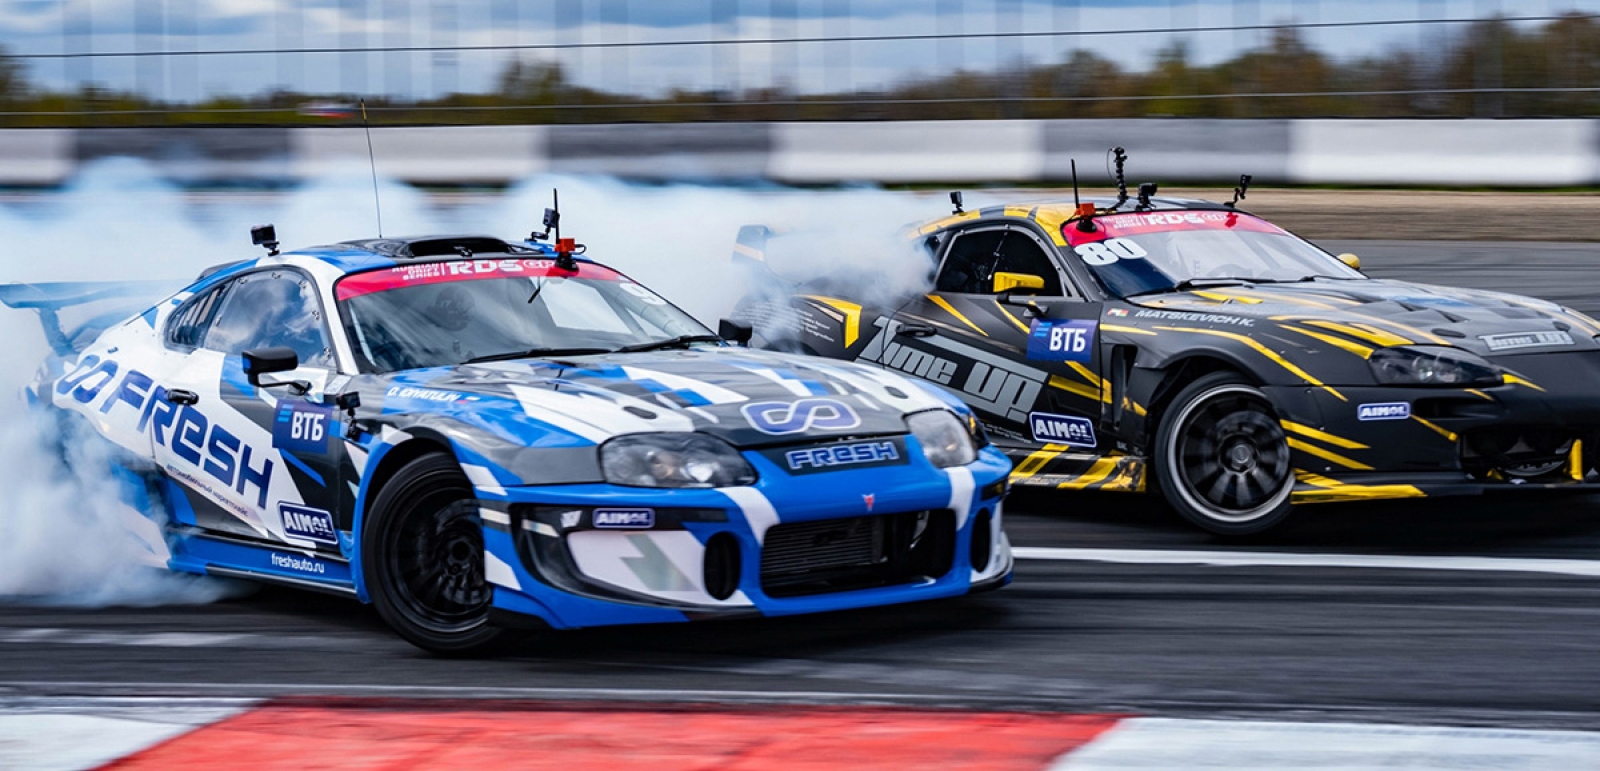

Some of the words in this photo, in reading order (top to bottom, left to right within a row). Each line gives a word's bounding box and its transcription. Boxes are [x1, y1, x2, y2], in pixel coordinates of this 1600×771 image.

[1143, 213, 1205, 225] RDS
[1074, 238, 1148, 266] 80
[403, 271, 440, 280] SERIES
[446, 260, 523, 275] RDS
[1135, 309, 1241, 324] MATSKEVICH
[1239, 318, 1256, 327] K.
[1049, 327, 1087, 352] ВТБ
[1361, 407, 1406, 417] AIMOL
[291, 411, 325, 441] ВТБ
[1035, 419, 1091, 439] AIMOL
[283, 511, 333, 534] AIMOL
[595, 512, 648, 524] AIMOL
[271, 552, 325, 574] freshauto.ru
